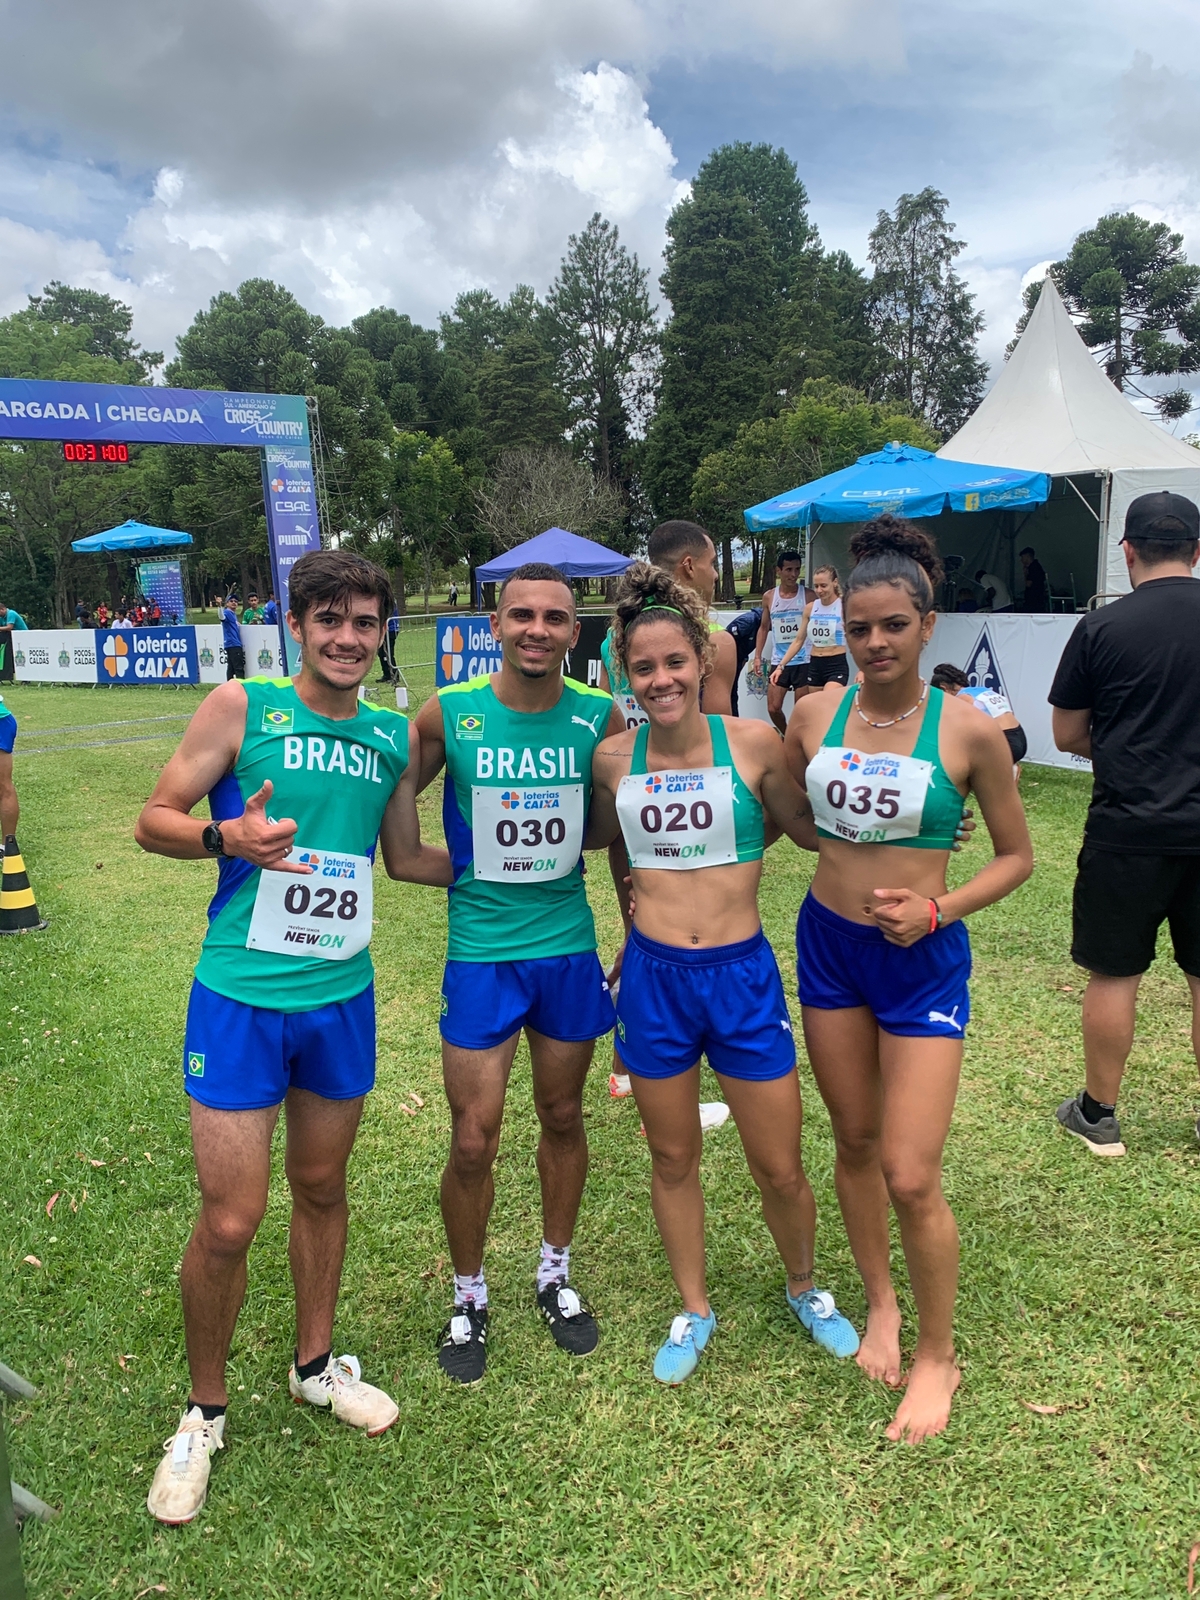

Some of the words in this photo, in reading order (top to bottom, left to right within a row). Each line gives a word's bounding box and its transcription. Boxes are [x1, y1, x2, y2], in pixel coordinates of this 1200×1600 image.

[224, 397, 277, 405] CAMPEONATO
[106, 405, 204, 424] CHEGADA
[223, 408, 262, 425] CROSS
[255, 420, 304, 436] COUNTRY
[267, 454, 289, 463] CROSS
[283, 460, 311, 469] COUNTRY
[278, 534, 308, 546] PUMA
[780, 624, 799, 634] 004
[812, 628, 830, 637] 003
[132, 632, 188, 654] loterias
[29, 649, 46, 657] POÇOS
[74, 649, 91, 657] POÇOS
[29, 657, 50, 665] CALDAS
[74, 657, 96, 665] CALDAS
[134, 657, 190, 678] CAIXA
[283, 735, 383, 784] BRASIL
[476, 746, 582, 779] BRASIL
[865, 757, 901, 768] loterias
[665, 772, 704, 783] loterias
[862, 766, 898, 778] CAIXA
[666, 781, 705, 793] CAIXA
[523, 790, 560, 800] loterias
[826, 779, 902, 819] 035
[523, 799, 560, 810] CAIXA
[640, 800, 713, 833] 020
[495, 817, 566, 847] 030
[323, 856, 356, 868] loterias
[322, 866, 356, 880] CAIXA
[284, 883, 359, 921] 028
